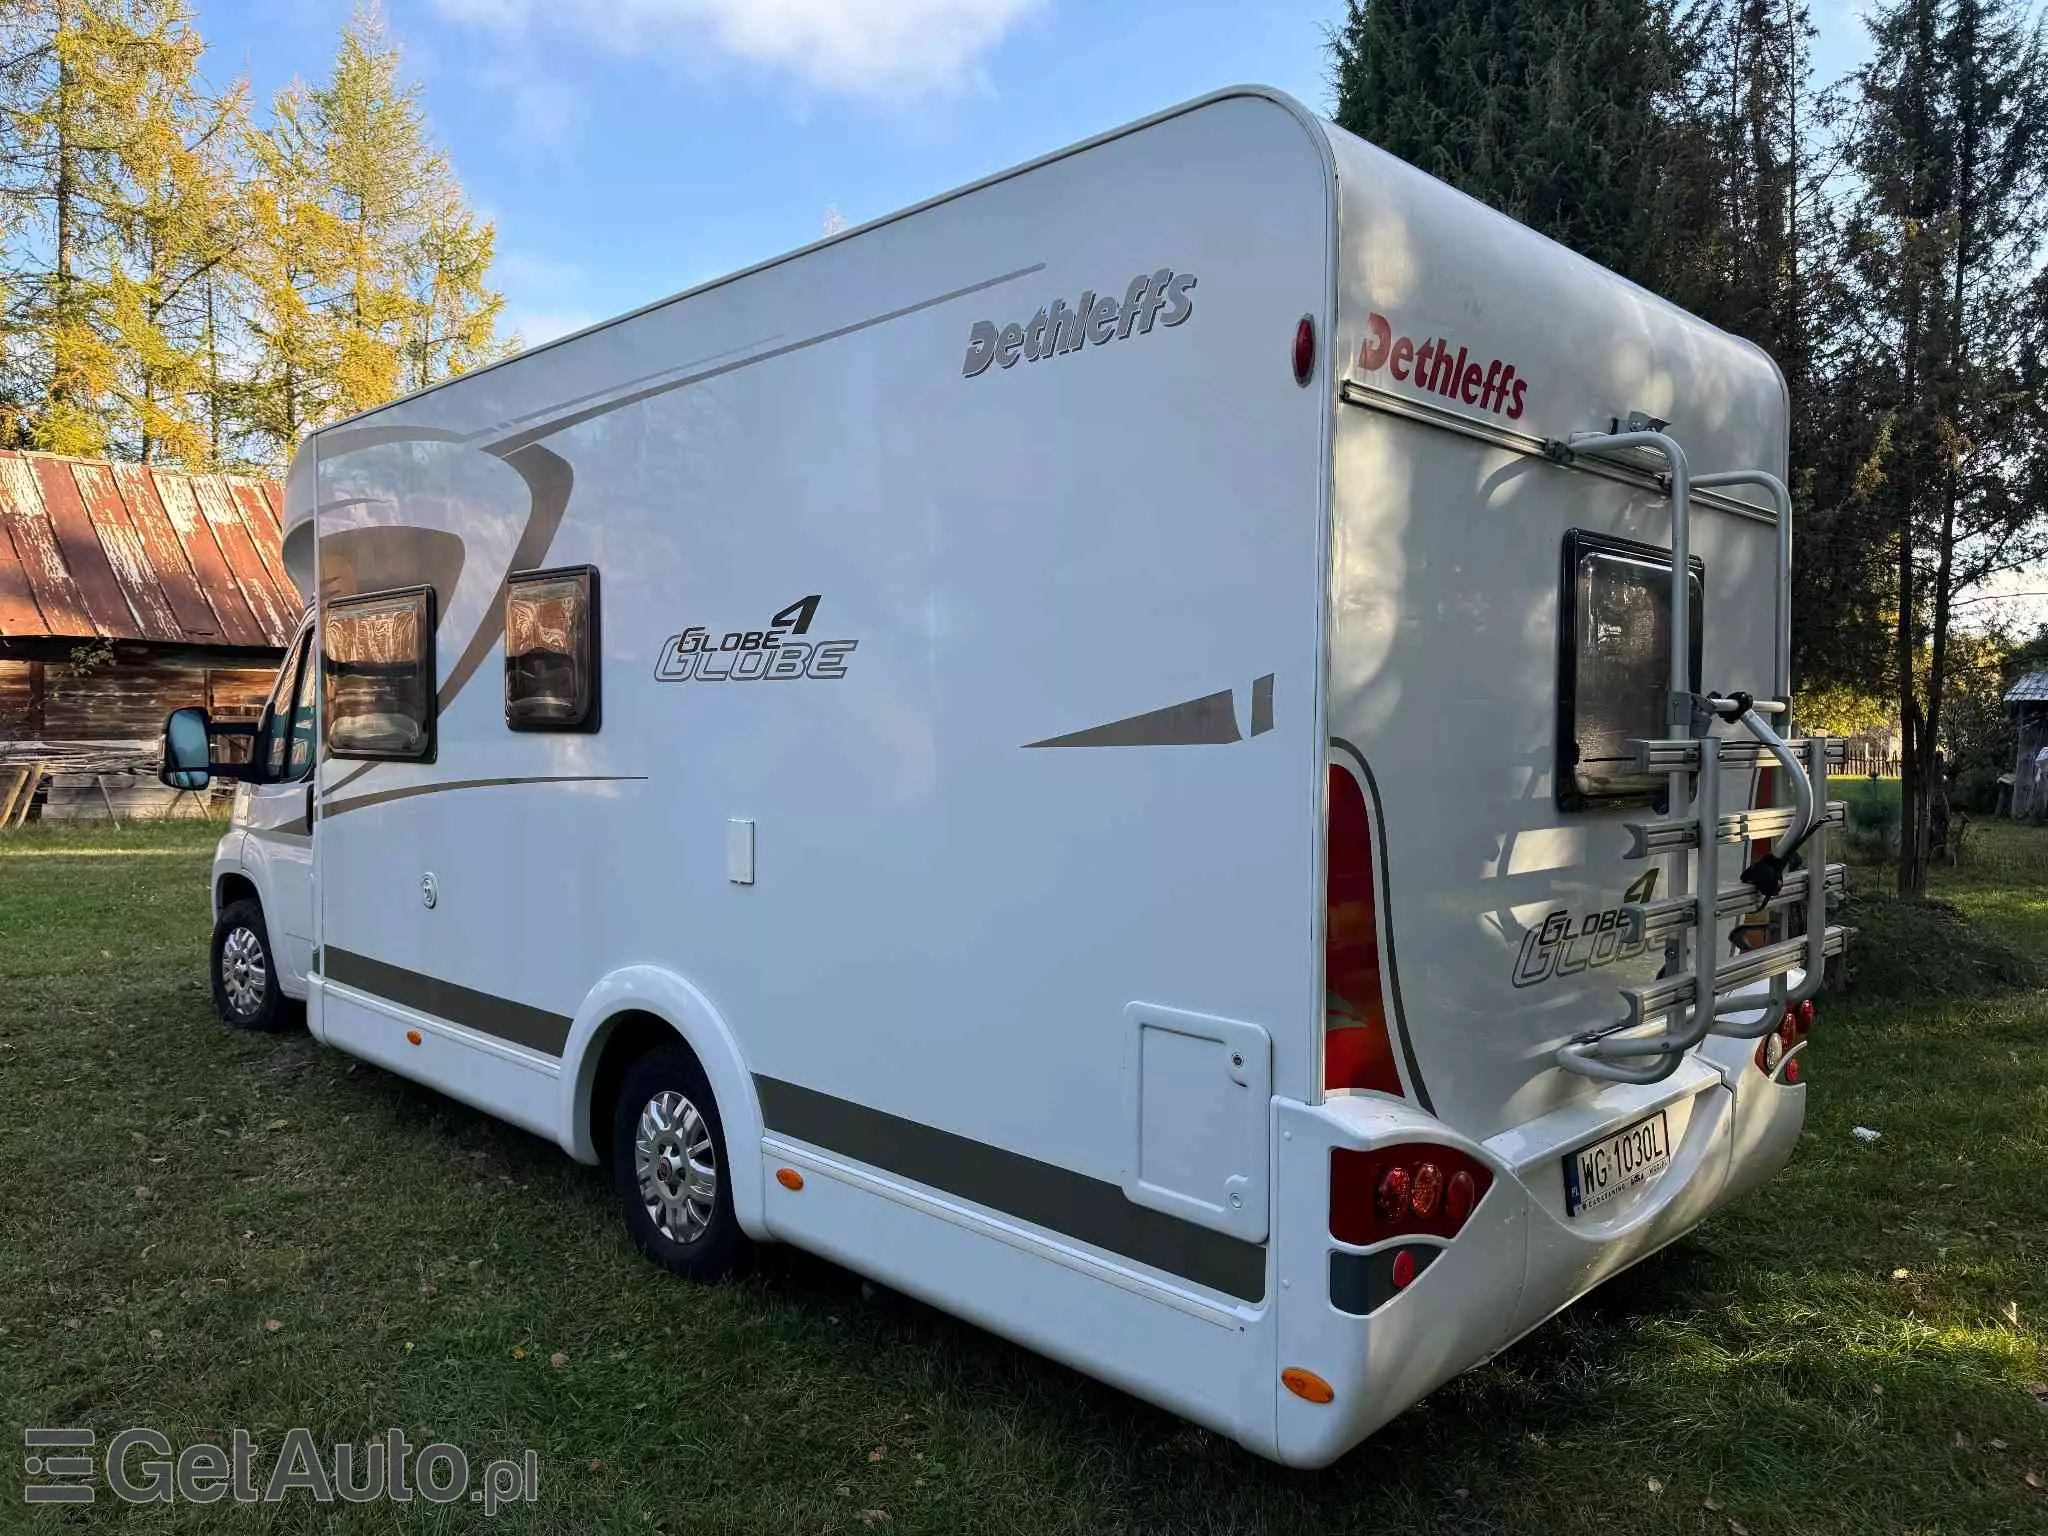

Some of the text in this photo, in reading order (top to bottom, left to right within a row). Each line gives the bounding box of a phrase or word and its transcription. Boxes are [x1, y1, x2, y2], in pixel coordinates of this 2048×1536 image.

[962, 268, 1197, 378] Dethleffs
[1358, 312, 1527, 419] Dethleffs
[771, 594, 822, 634] 4
[1581, 1122, 1663, 1195] WG 1030L
